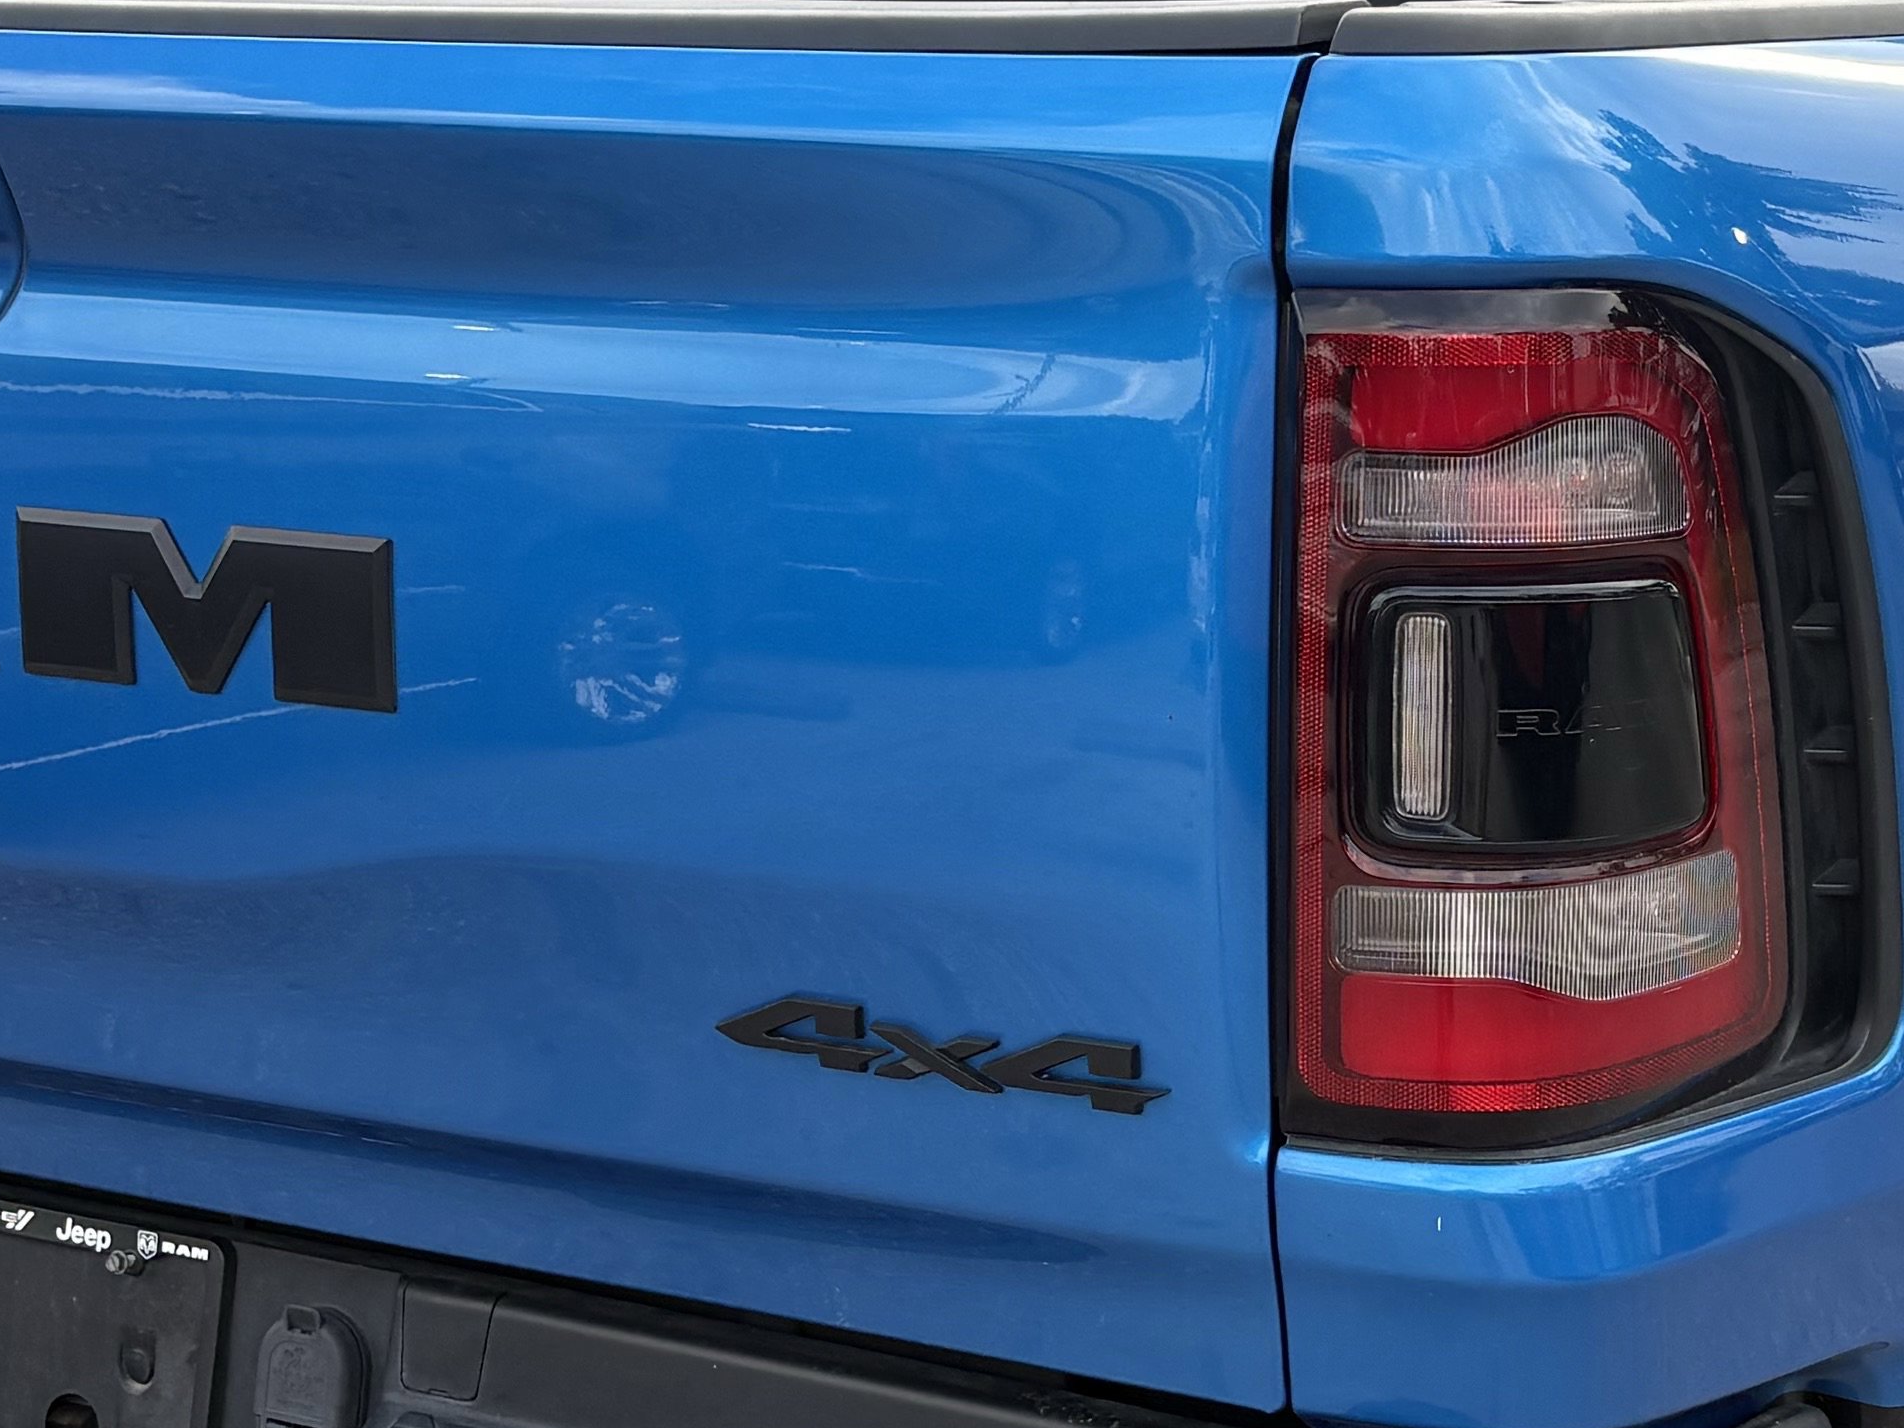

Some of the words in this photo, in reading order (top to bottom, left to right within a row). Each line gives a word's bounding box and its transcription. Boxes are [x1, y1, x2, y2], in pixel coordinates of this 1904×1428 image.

[1496, 700, 1658, 737] RA
[54, 1217, 112, 1253] Jeep
[160, 1241, 209, 1262] RAM
